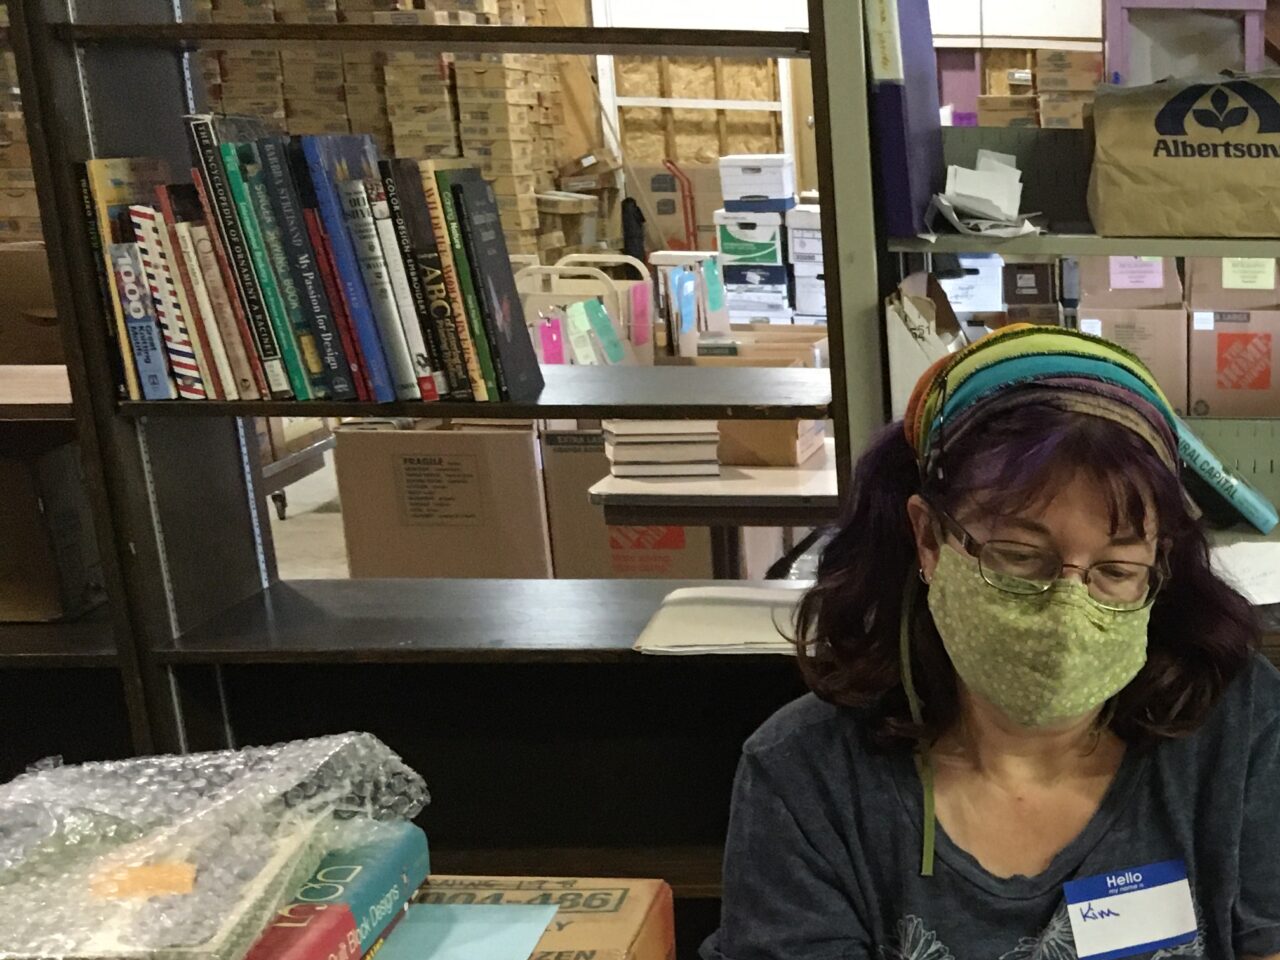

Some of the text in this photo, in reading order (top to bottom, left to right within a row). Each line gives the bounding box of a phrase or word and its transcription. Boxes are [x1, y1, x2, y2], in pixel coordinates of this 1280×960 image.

[198, 125, 210, 147] THE
[202, 152, 231, 221] ENCYCLOPEDIA
[228, 228, 239, 243] OF
[254, 183, 299, 310] SINGER BOOK
[424, 189, 452, 261] WILDLIFE
[450, 221, 463, 250] Nature
[117, 251, 145, 320] 1000
[232, 245, 256, 301] ORNAMENT
[418, 262, 452, 320] ABC
[298, 253, 340, 371] My Passion for Design
[403, 457, 444, 467] FRAGILE
[1200, 459, 1239, 501] CAPITAL
[1106, 869, 1143, 889] Hello
[346, 919, 374, 957] Block
[368, 884, 400, 938] Designs
[1080, 903, 1120, 923] Kim
